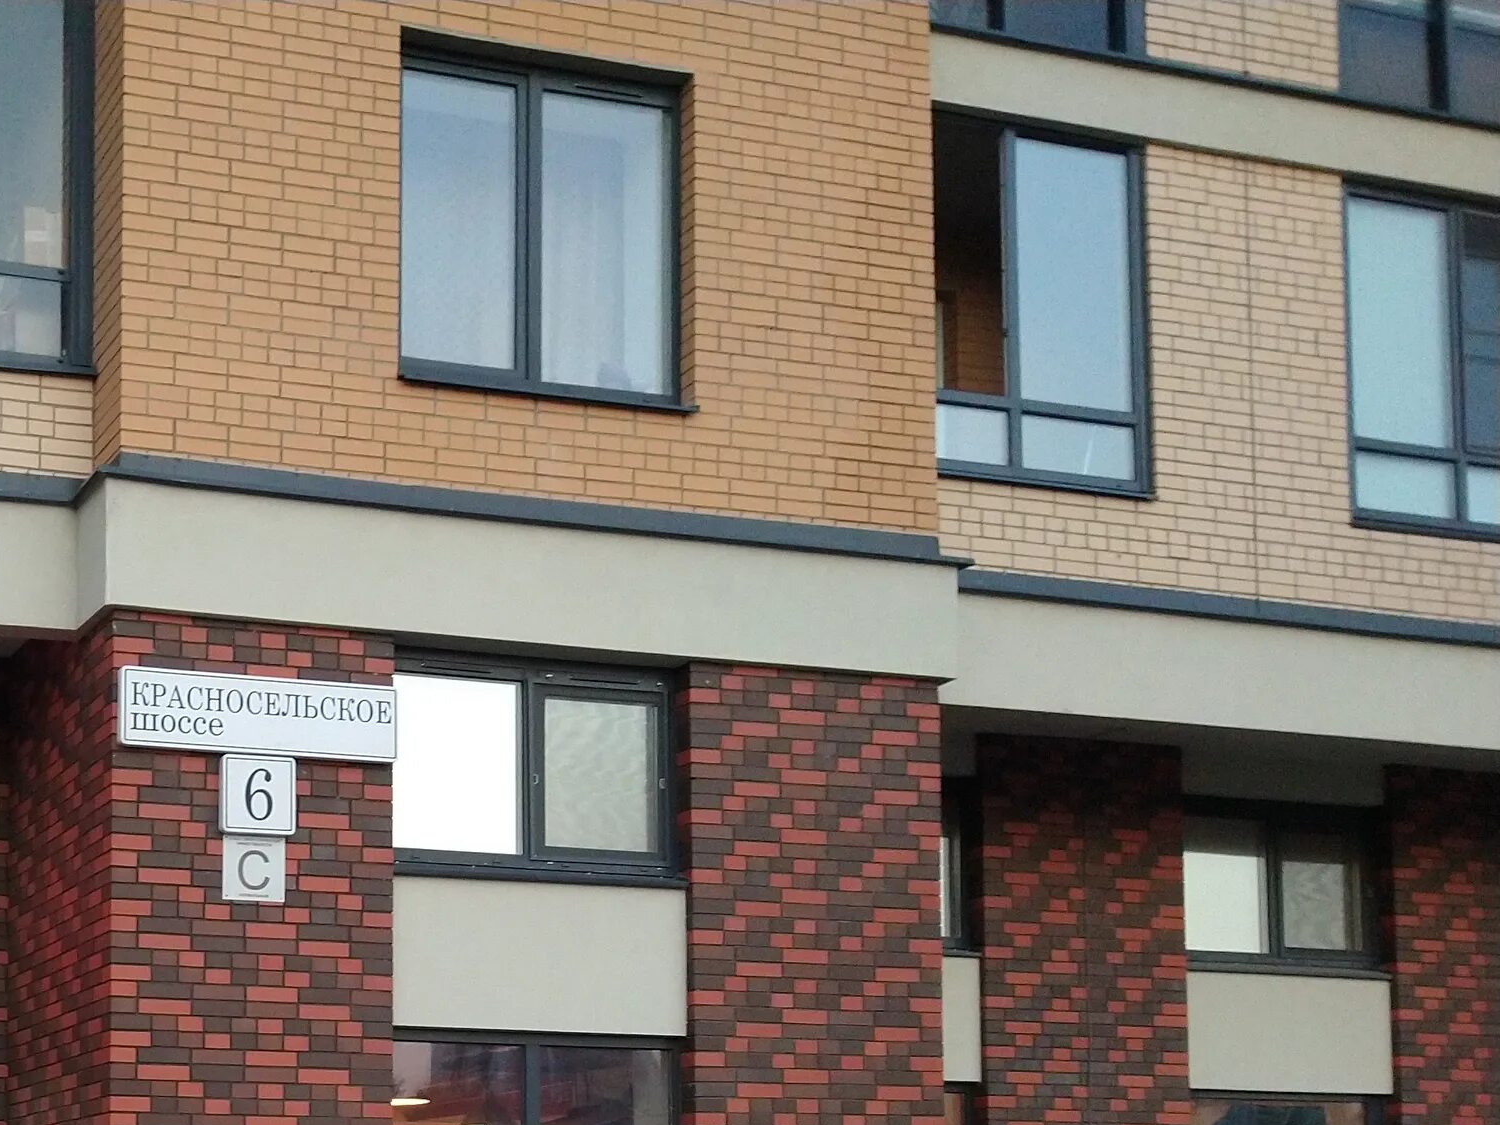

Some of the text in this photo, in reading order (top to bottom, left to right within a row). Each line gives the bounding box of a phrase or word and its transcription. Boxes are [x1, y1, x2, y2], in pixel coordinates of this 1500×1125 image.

[130, 681, 393, 725] КРАСНОСЕЛЬСКОЕ
[130, 711, 224, 736] шоссе
[244, 767, 274, 821] 6
